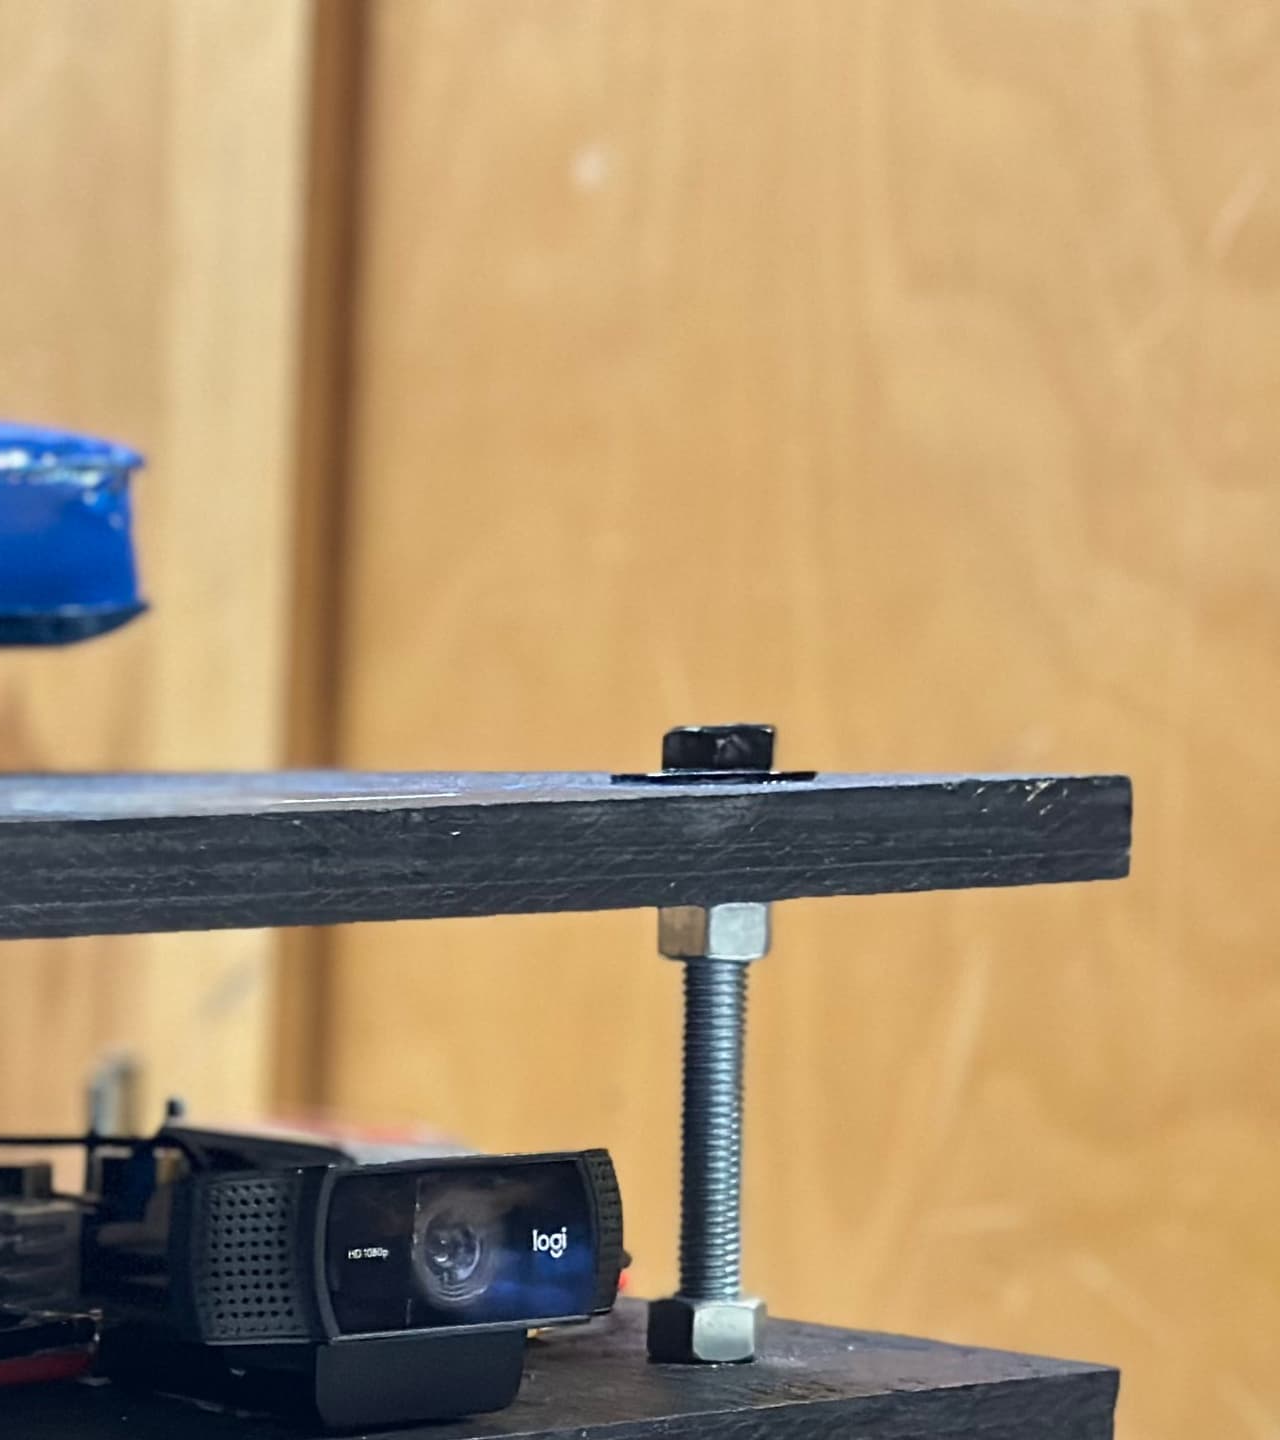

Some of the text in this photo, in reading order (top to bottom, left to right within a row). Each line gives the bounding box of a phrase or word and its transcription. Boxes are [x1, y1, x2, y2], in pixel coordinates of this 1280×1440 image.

[532, 1226, 567, 1258] logi
[348, 1247, 389, 1260] HD 1080p
